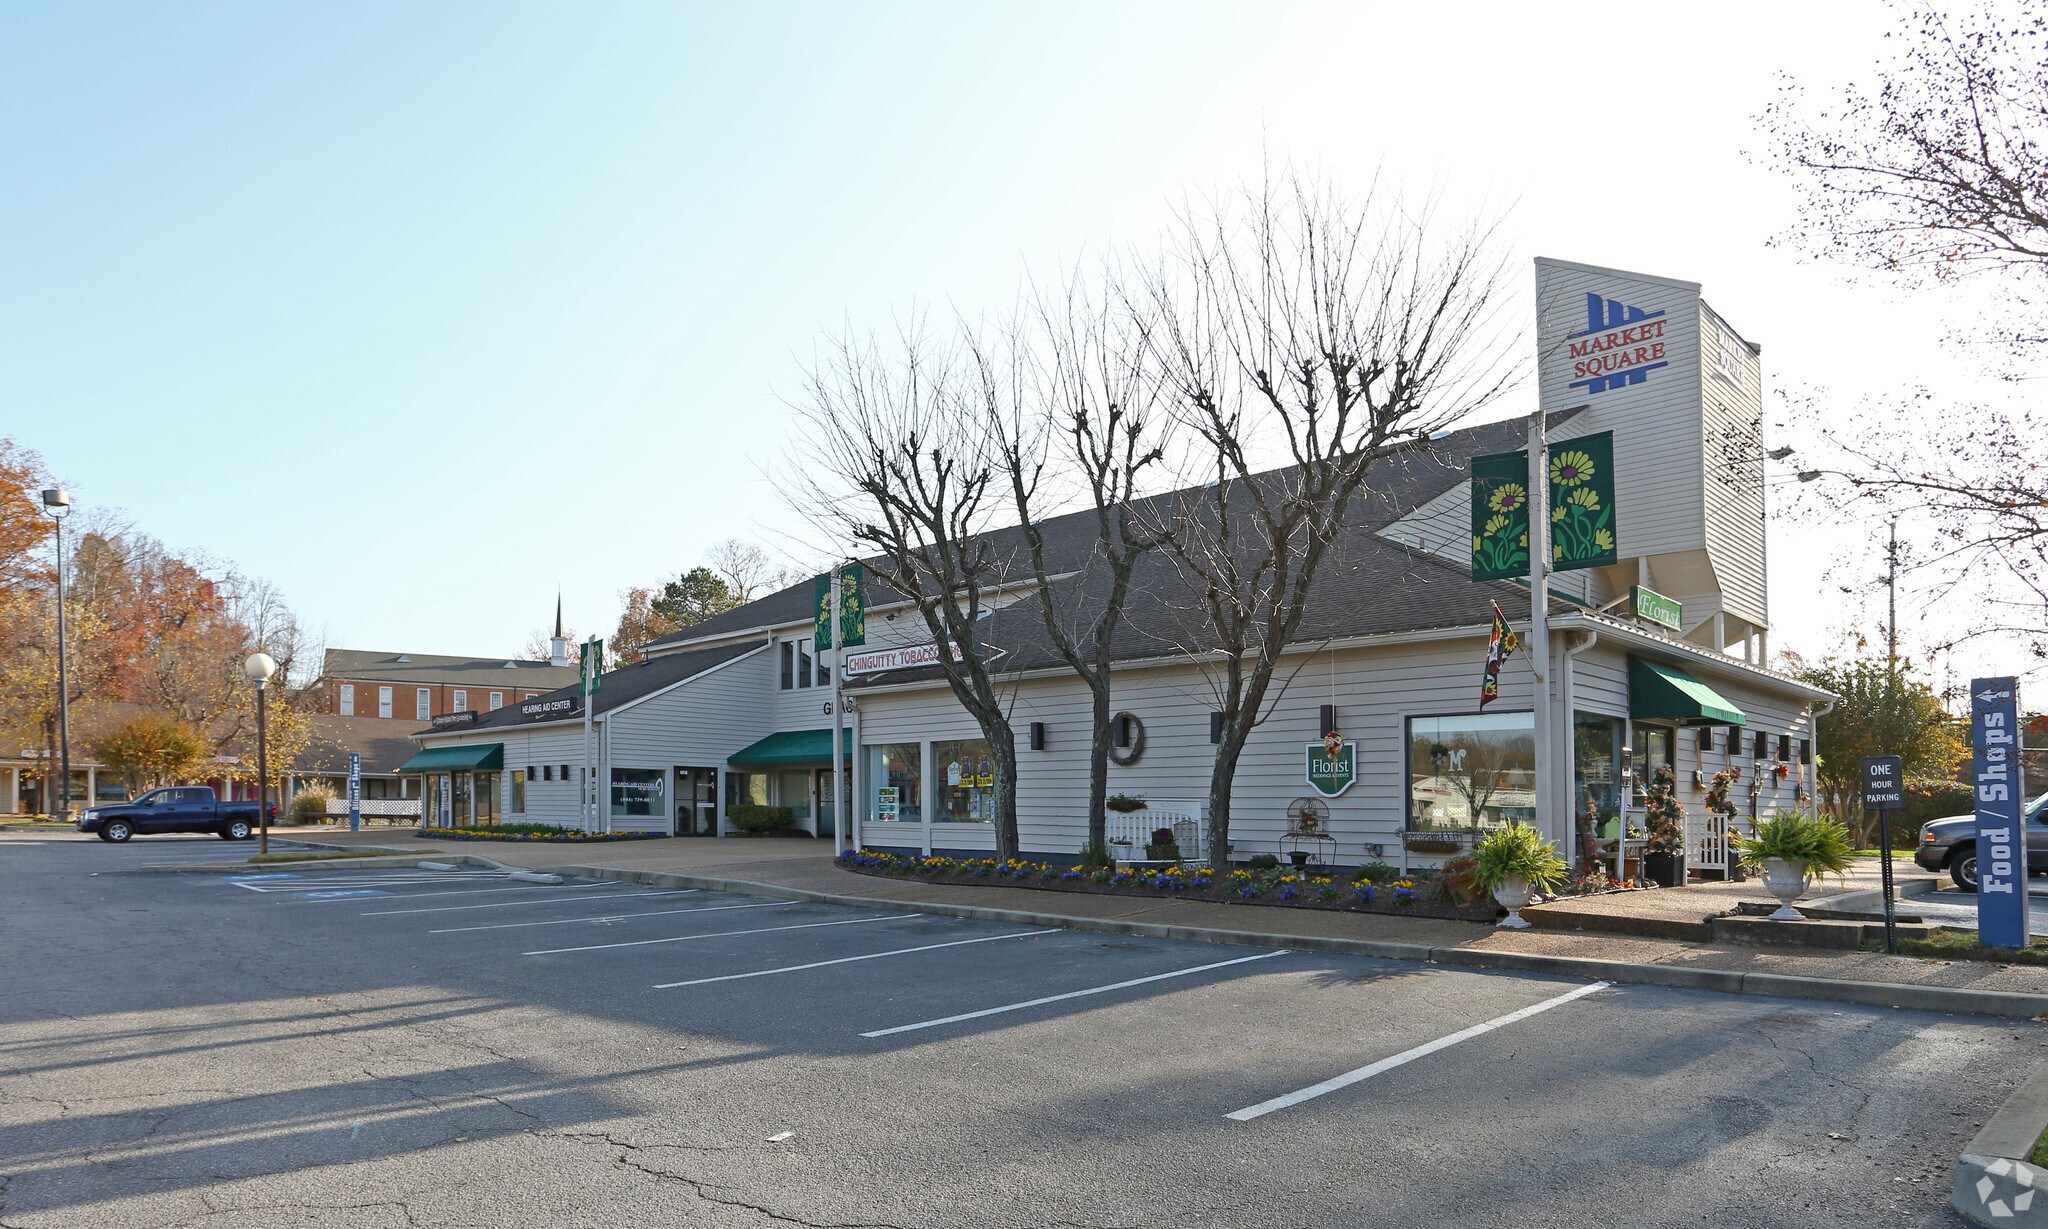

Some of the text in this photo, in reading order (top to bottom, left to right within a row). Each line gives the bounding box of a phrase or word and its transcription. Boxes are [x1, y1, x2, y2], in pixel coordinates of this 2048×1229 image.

[1568, 319, 1667, 359] MARKET
[1574, 342, 1666, 379] SQUARE
[1639, 594, 1680, 627] Florist
[849, 652, 897, 672] CHINGUITTY
[522, 700, 571, 714] HEARING AID CENTER
[1312, 758, 1350, 773] Florist
[1978, 712, 2013, 801] Shops
[1870, 764, 1892, 776] ONE
[1871, 780, 1893, 789] HOUR
[1866, 793, 1900, 803] PARKING
[1982, 827, 2013, 893] Food
